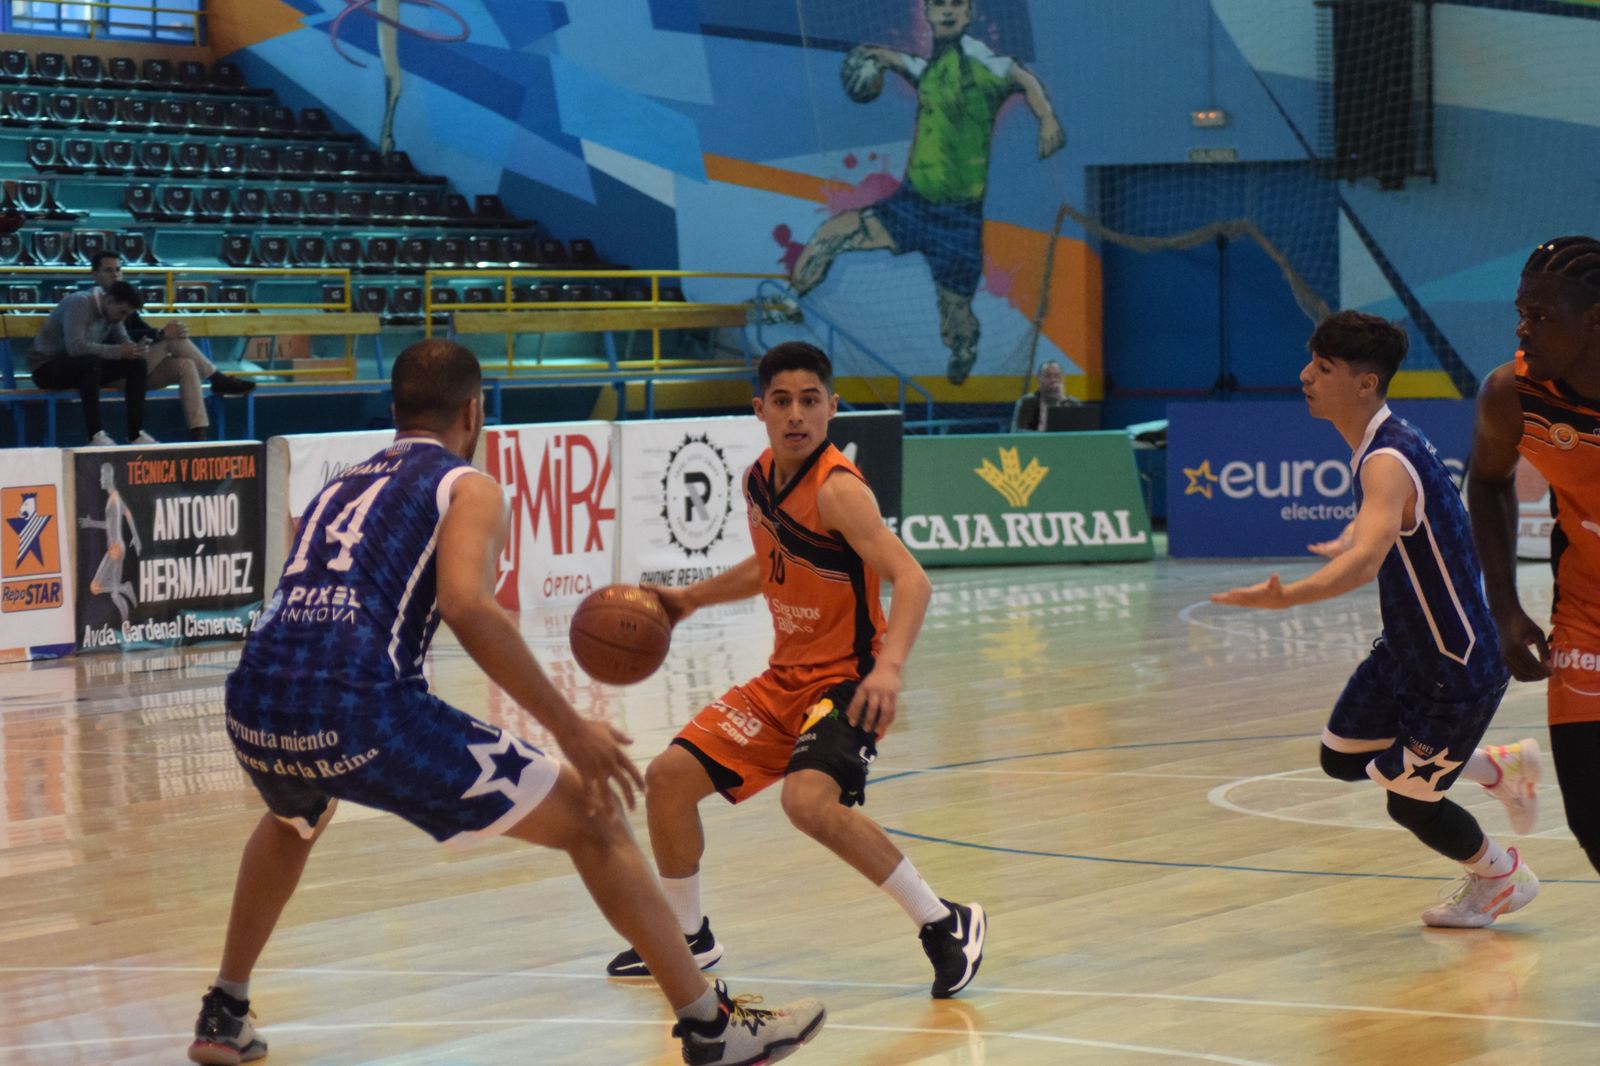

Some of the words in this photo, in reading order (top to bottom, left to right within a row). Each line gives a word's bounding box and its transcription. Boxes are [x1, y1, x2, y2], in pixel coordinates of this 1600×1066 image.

[127, 455, 176, 485] TÉCNICA
[180, 459, 190, 481] Y
[191, 455, 256, 481] ORTOPEDIA
[1219, 460, 1351, 499] euro
[153, 492, 240, 542] ANTONIO
[284, 475, 391, 577] 14
[1280, 502, 1357, 520] electrod
[901, 513, 998, 551] CAJA
[1000, 510, 1147, 548] RURAL
[139, 544, 254, 602] HERNÁNDEZ
[543, 570, 593, 598] ÓPTICA
[287, 586, 362, 608] PIXEL
[122, 613, 183, 643] Cardenal
[281, 607, 355, 624] INNOVA
[314, 747, 380, 779] Reina
